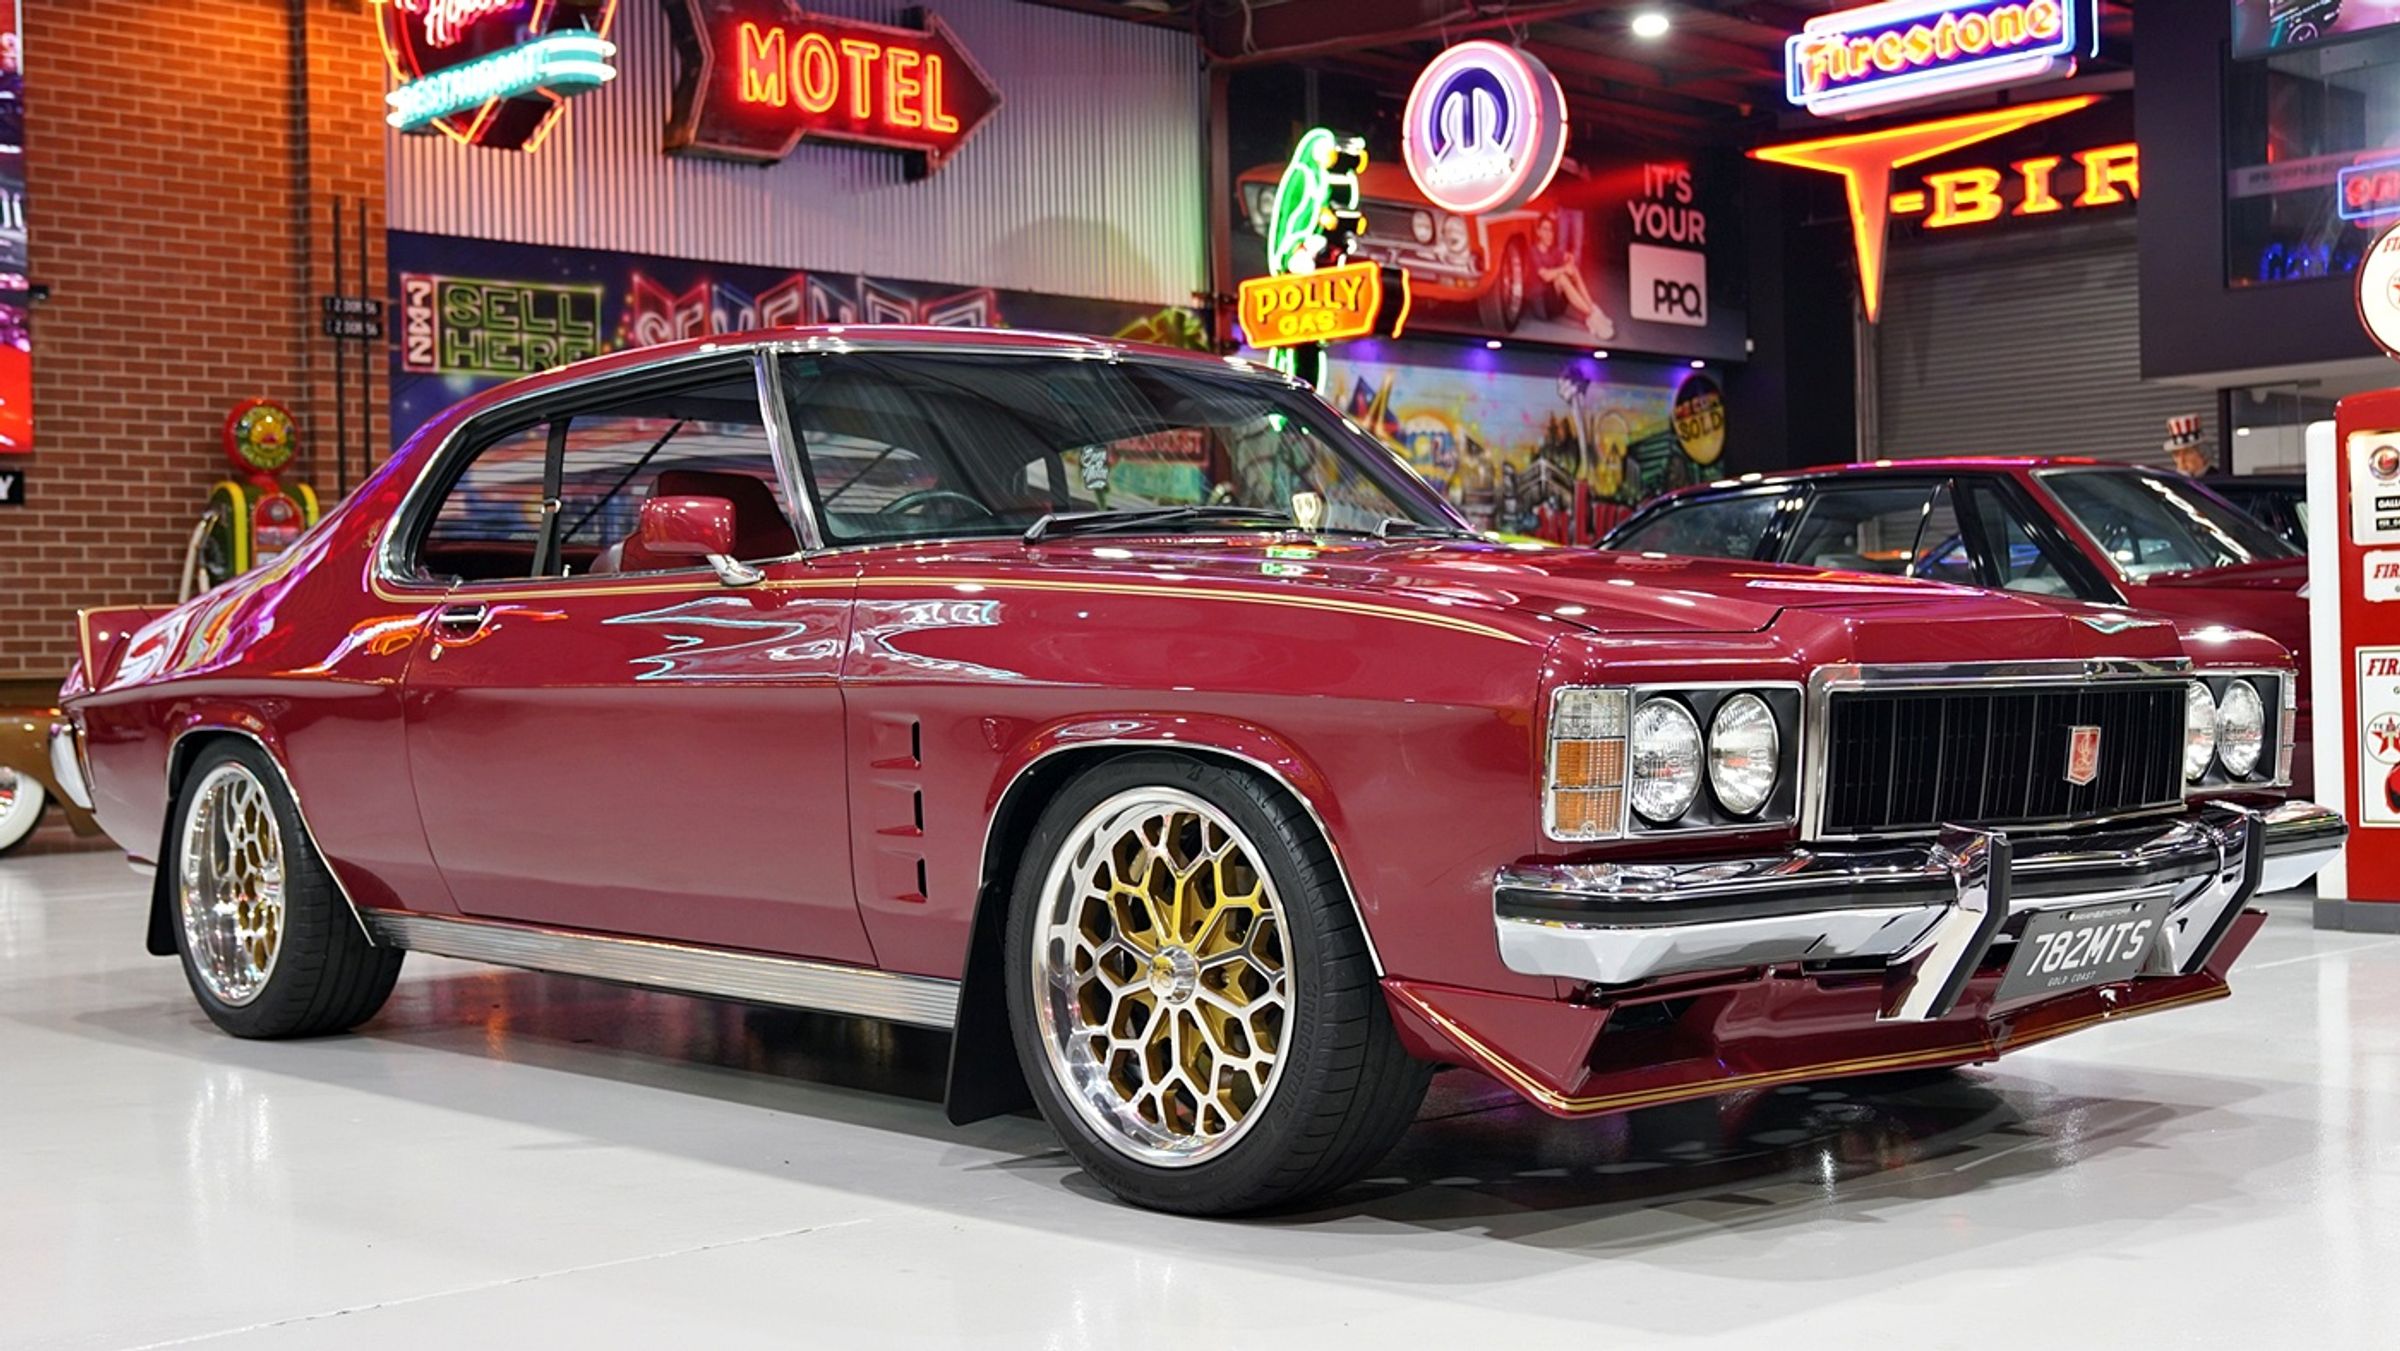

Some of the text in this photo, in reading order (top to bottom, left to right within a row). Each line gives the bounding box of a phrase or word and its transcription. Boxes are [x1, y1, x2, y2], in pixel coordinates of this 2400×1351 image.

[1797, 2, 2062, 95] Firestone
[740, 21, 959, 134] MOTEL
[1644, 162, 1693, 204] IT'S
[1627, 199, 1706, 245] YOUR
[444, 284, 595, 336] SELL
[1253, 275, 1363, 323] POLLY
[1653, 278, 1702, 319] PPQ
[1278, 309, 1336, 336] GAS
[1678, 410, 1723, 442] SOLD
[2026, 919, 2152, 977] 782MTS
[2047, 971, 2097, 987] GOLD COAST
